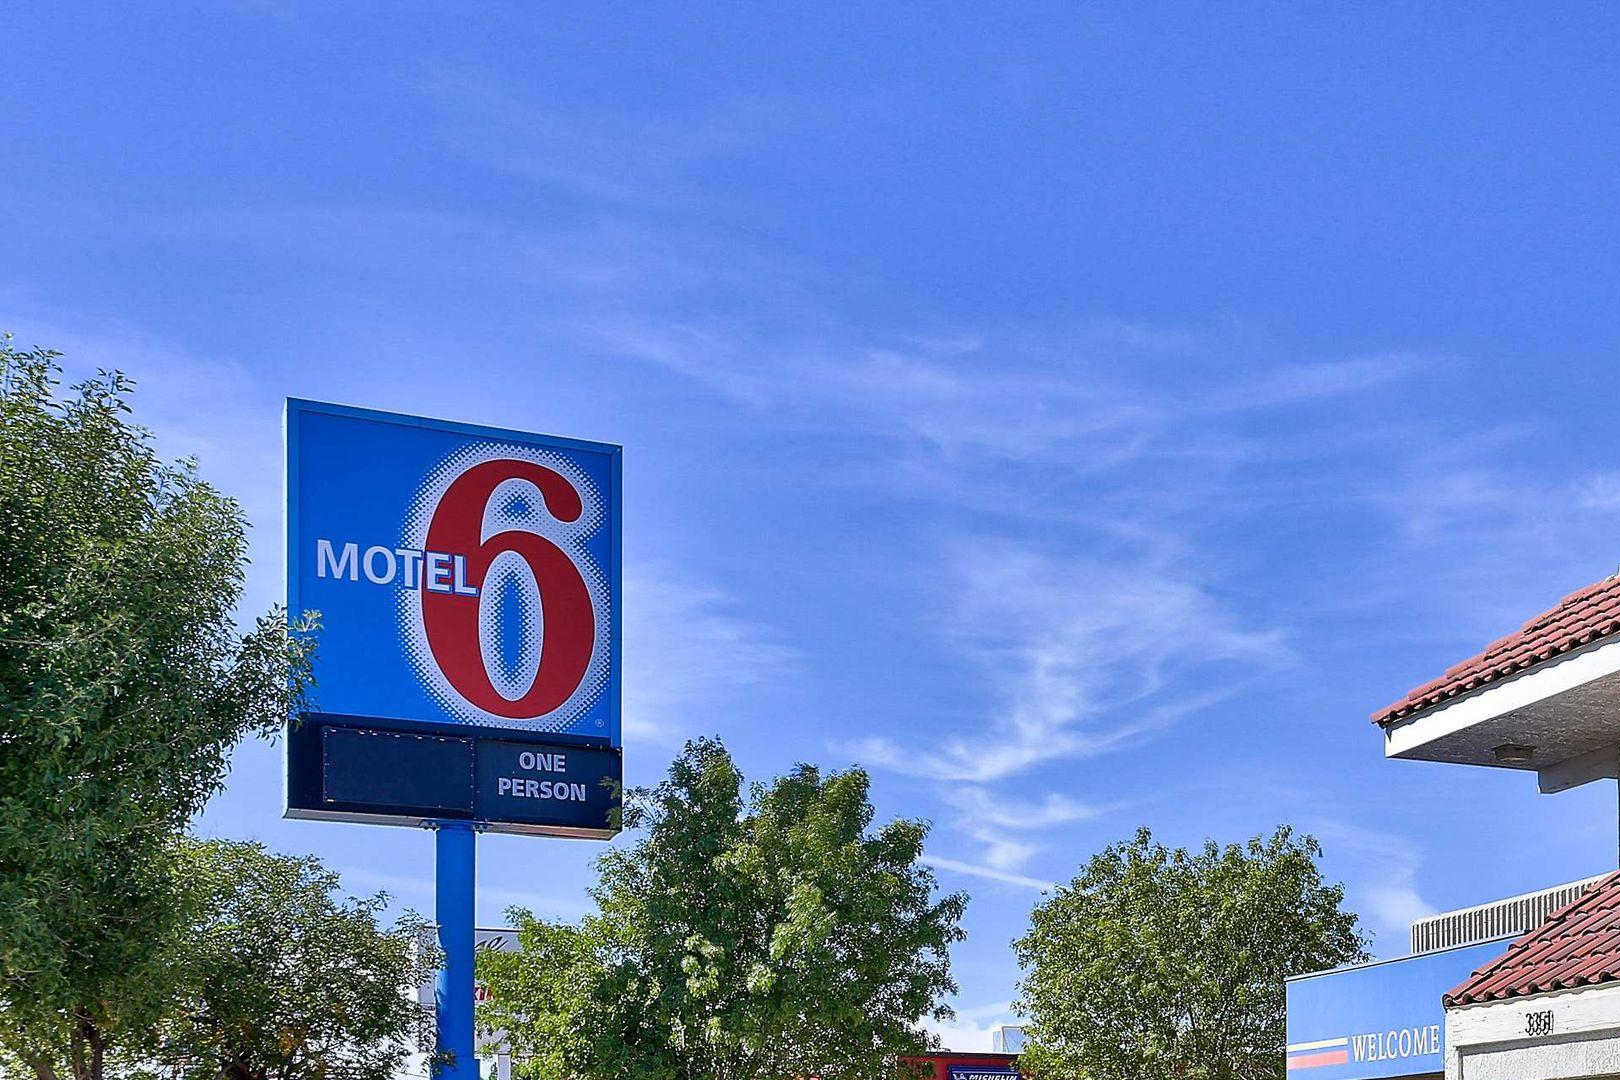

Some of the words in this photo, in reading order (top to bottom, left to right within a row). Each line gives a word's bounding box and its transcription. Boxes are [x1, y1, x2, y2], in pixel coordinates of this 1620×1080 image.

[316, 538, 479, 595] MOTEL
[421, 458, 594, 719] 6
[519, 751, 565, 772] ONE
[498, 778, 586, 801] PERSON
[1525, 1010, 1554, 1036] 3351
[1352, 1024, 1440, 1062] WELCOME
